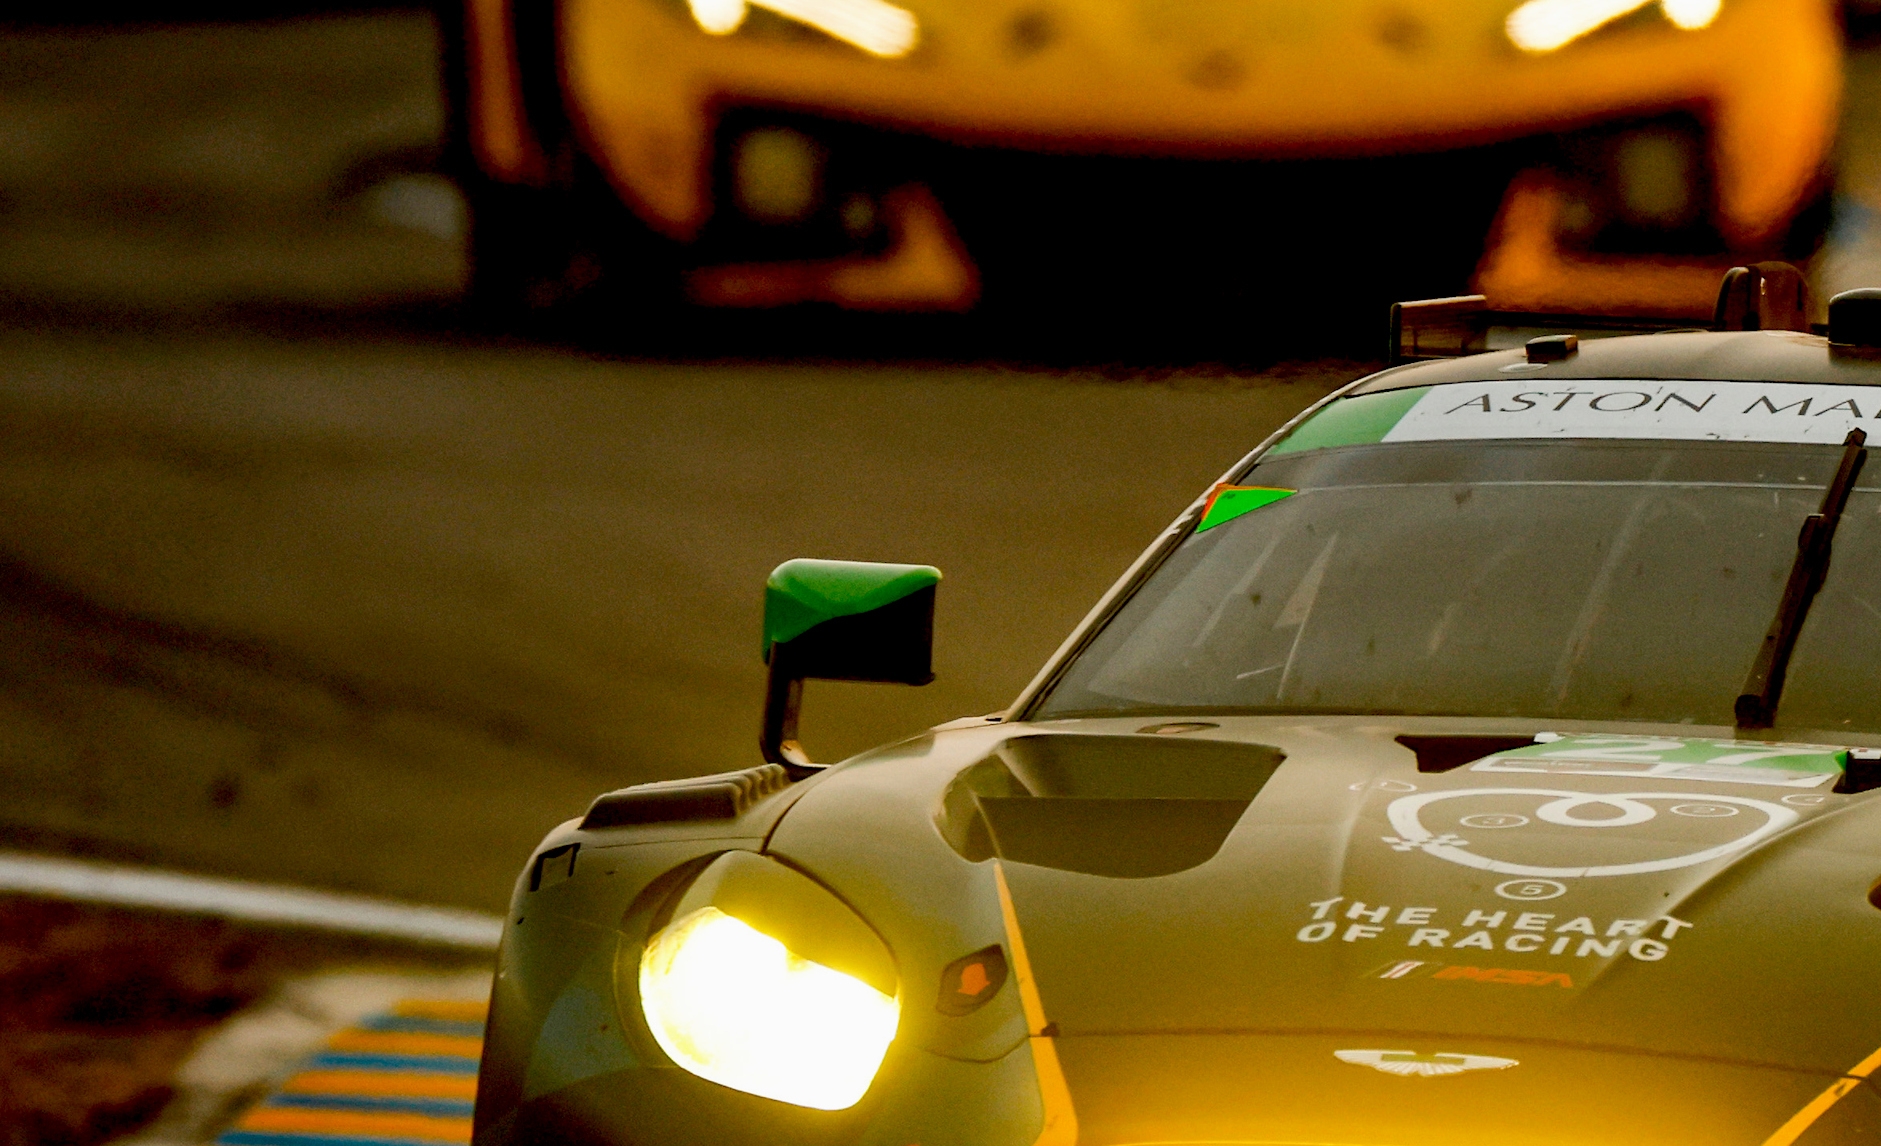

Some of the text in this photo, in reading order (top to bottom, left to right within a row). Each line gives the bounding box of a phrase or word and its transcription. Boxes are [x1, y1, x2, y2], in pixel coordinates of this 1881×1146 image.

[1444, 390, 1717, 413] ASTON
[1540, 738, 1835, 766] 27
[1310, 896, 1694, 940] THE HEART
[1296, 921, 1670, 962] OF RACING
